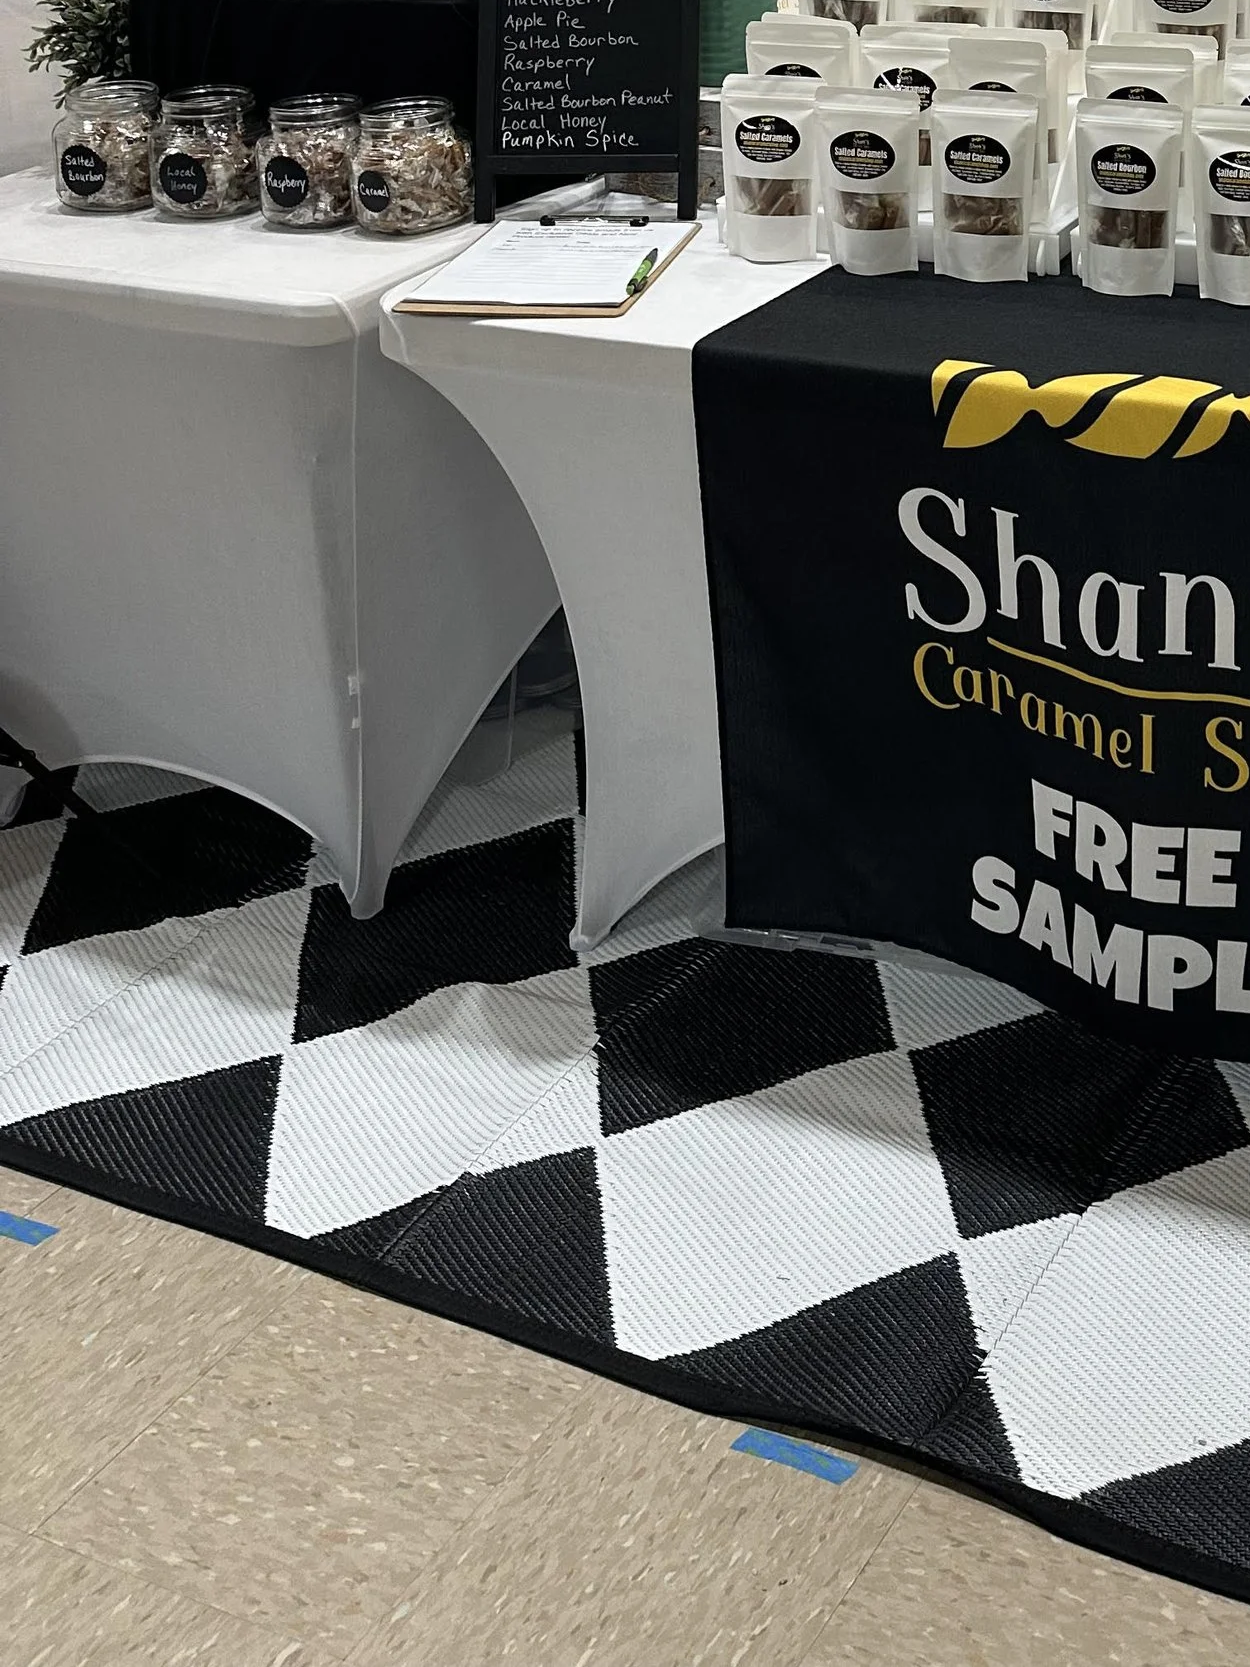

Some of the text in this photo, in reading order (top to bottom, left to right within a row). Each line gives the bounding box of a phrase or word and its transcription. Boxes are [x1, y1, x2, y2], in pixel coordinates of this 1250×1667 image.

[504, 11, 586, 32] Apple Pie
[503, 33, 639, 51] Salted Bourbon
[503, 53, 595, 76] Raspberry
[501, 77, 571, 91] Caramel
[501, 87, 673, 111] Salted Bourbon Peanut
[502, 114, 607, 135] Local Honey
[502, 130, 639, 152] Pumpkin Spice
[739, 131, 793, 143] Salted Caramels
[65, 154, 96, 168] Salted
[834, 146, 888, 160] Salted Caramels
[950, 150, 1004, 165] Salted Caramels
[67, 168, 104, 183] Bourbon
[167, 165, 196, 179] Local
[170, 179, 198, 195] Honey
[266, 173, 309, 193] Raspberry
[912, 641, 1156, 775] Caramel
[1031, 777, 1242, 909] FREE
